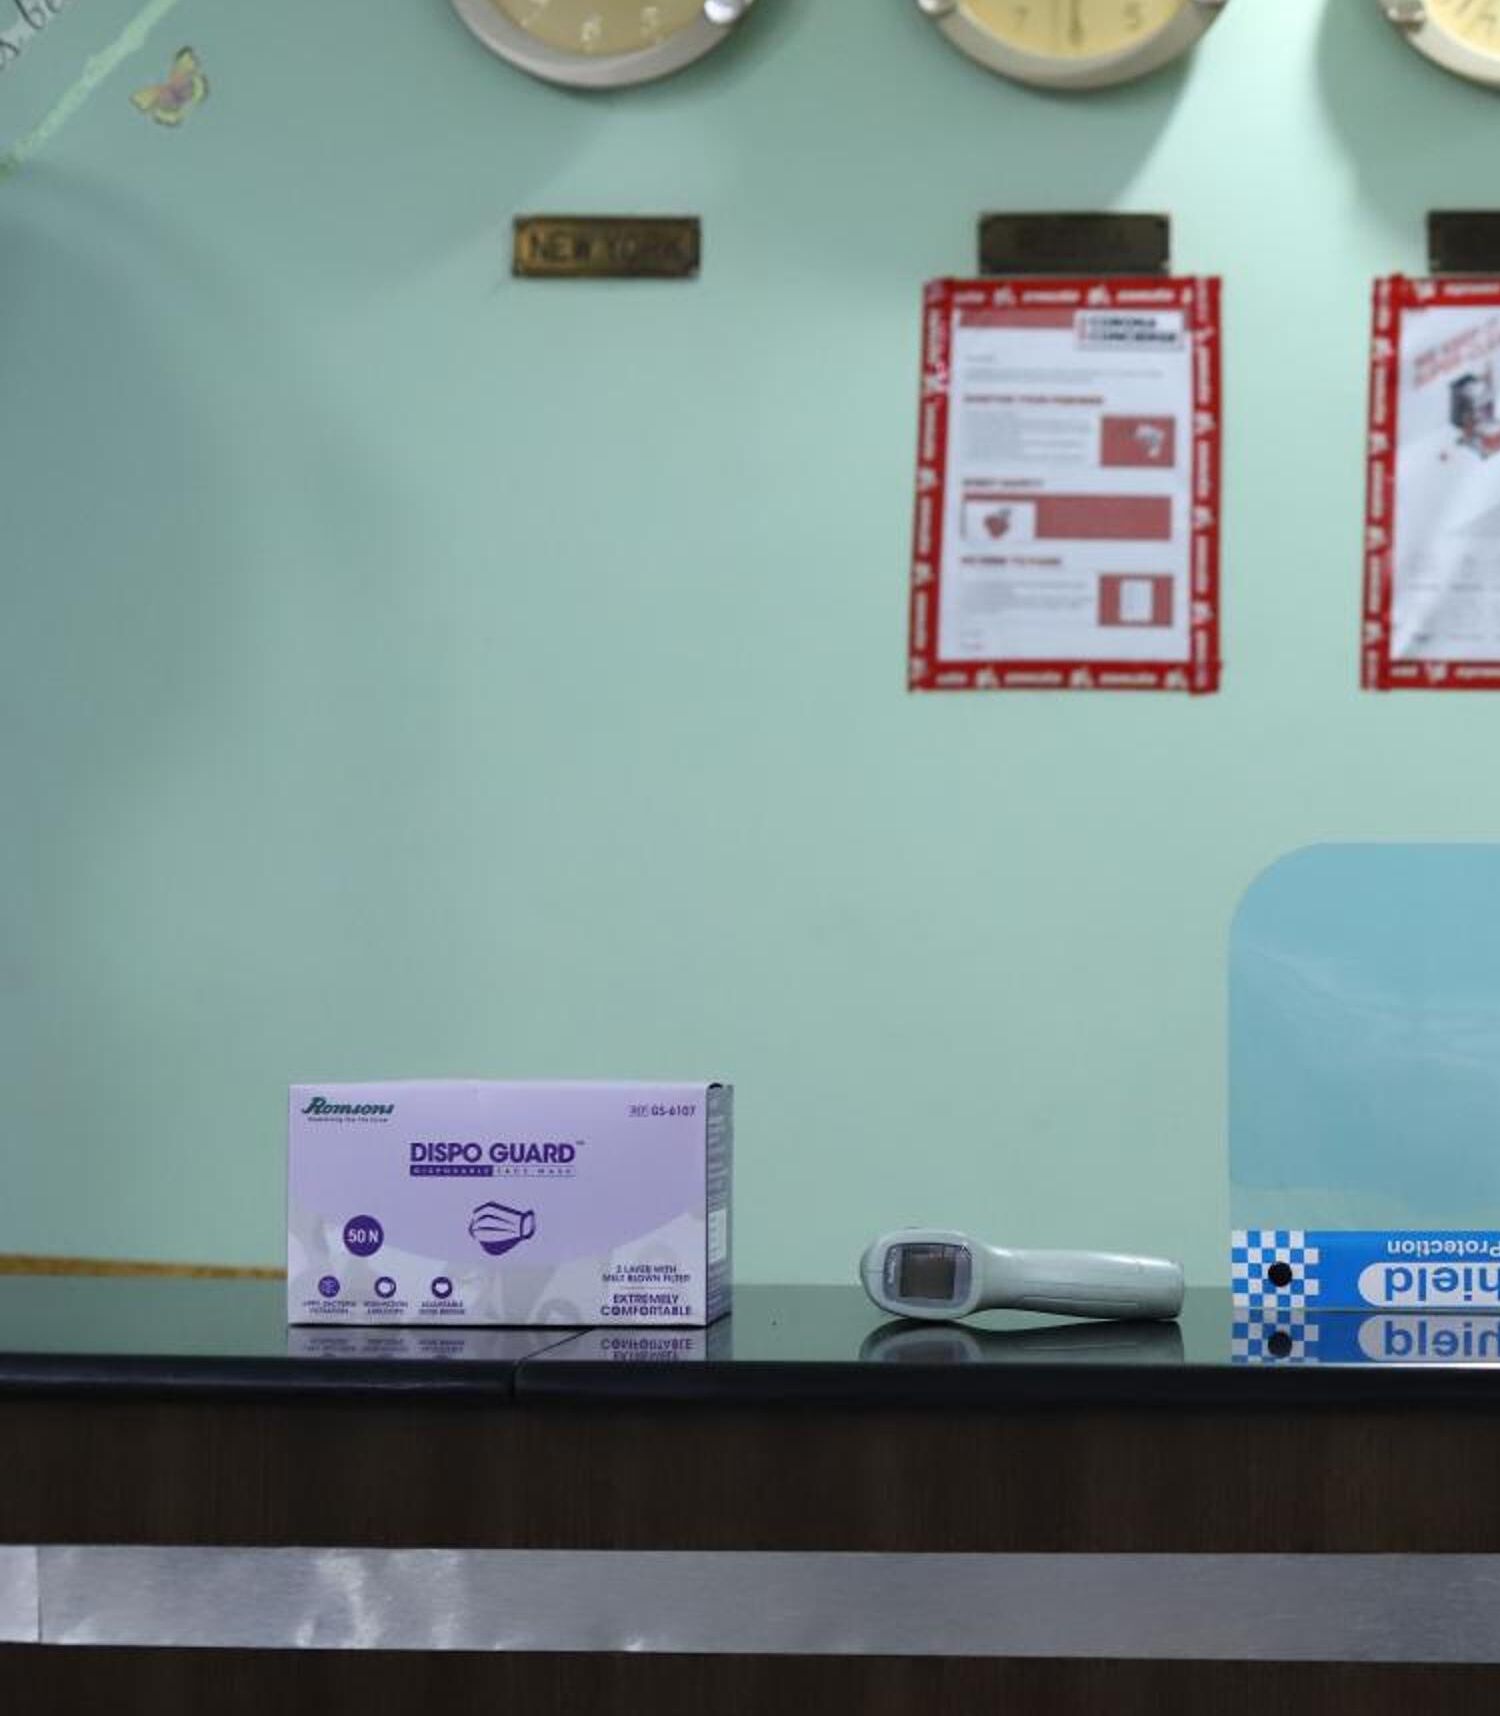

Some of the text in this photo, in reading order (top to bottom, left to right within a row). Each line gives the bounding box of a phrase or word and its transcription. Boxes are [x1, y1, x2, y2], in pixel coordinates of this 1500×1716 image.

[527, 230, 594, 263] NEW
[301, 1096, 396, 1116] Romsons
[410, 1142, 483, 1162] DISPO
[489, 1142, 576, 1164] GUARD
[349, 1228, 366, 1242] 50
